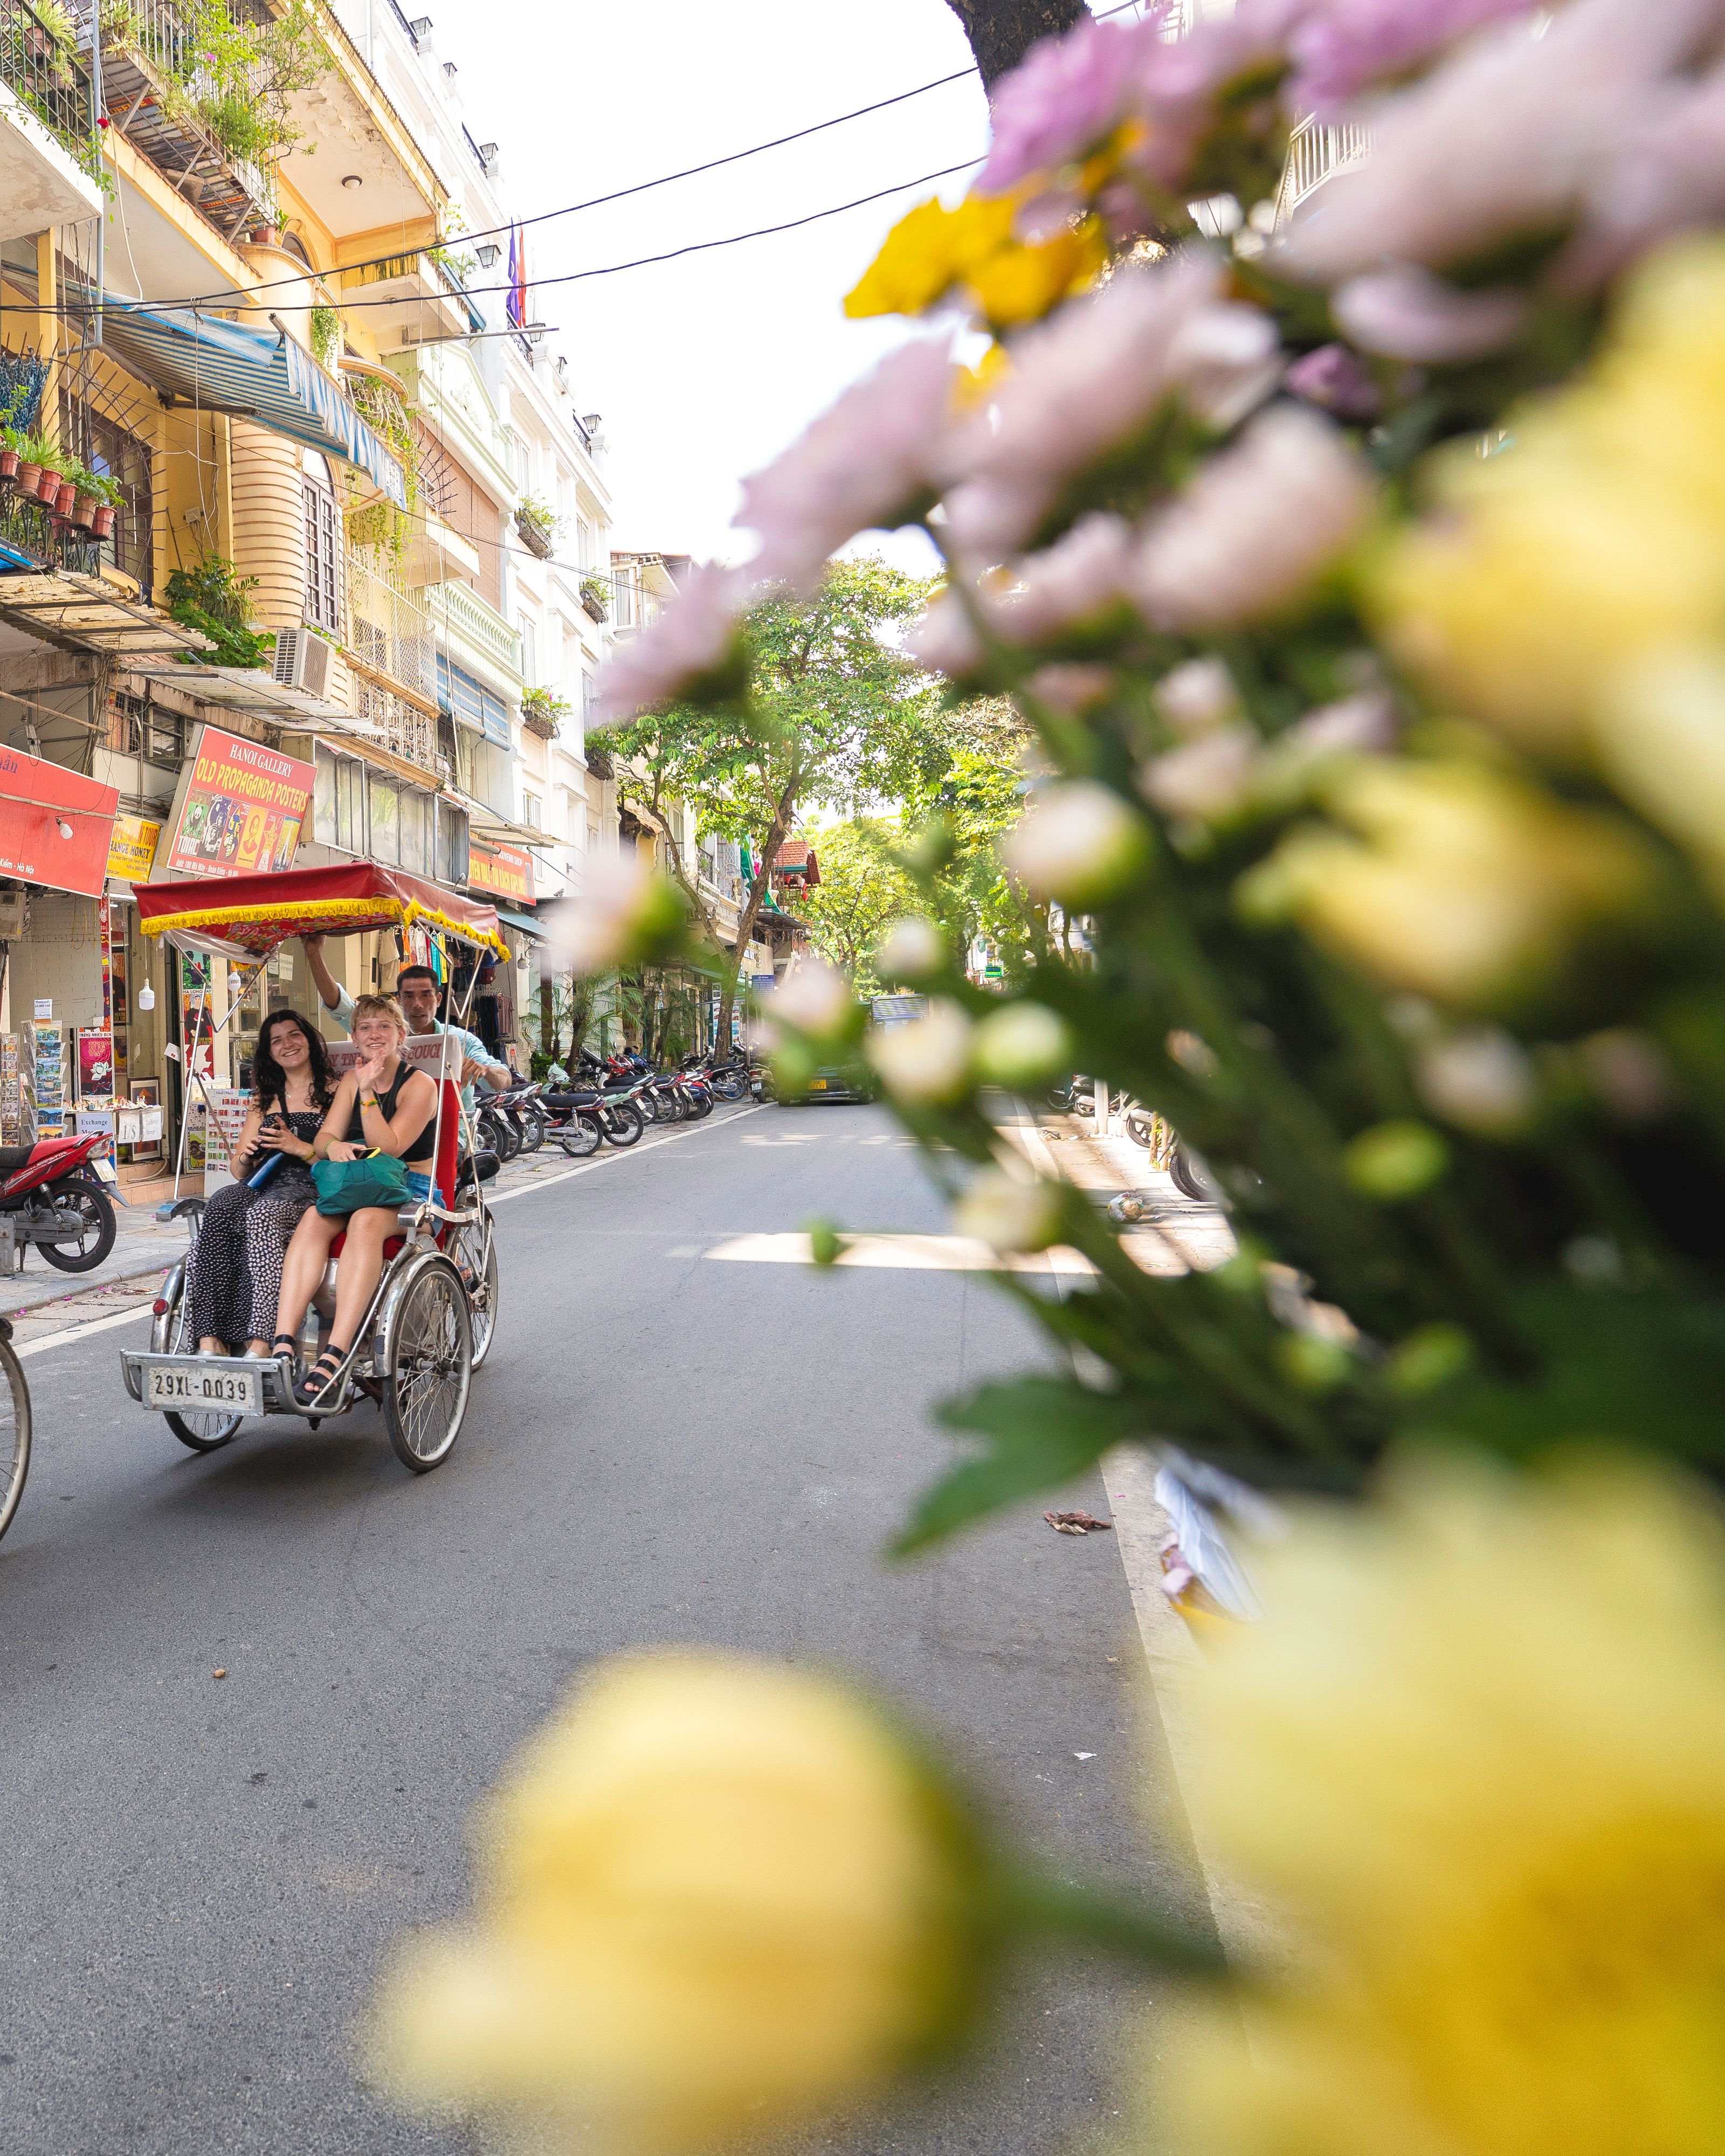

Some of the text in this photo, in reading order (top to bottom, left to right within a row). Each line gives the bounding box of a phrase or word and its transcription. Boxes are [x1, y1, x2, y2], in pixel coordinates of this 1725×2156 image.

[229, 744, 294, 778] HANOI GALLERY
[196, 757, 217, 783] OLD
[216, 764, 275, 803] PROPAGANDA
[274, 783, 309, 813] POSTERS
[144, 826, 158, 847] TOUR
[130, 845, 150, 859] MONEY
[514, 856, 523, 867] SHOP
[0, 858, 12, 869] Kiếm
[17, 862, 24, 872] Hà
[25, 865, 34, 876] Nội
[408, 1043, 443, 1060] SOUCI
[155, 1375, 246, 1400] 29XL-0039
